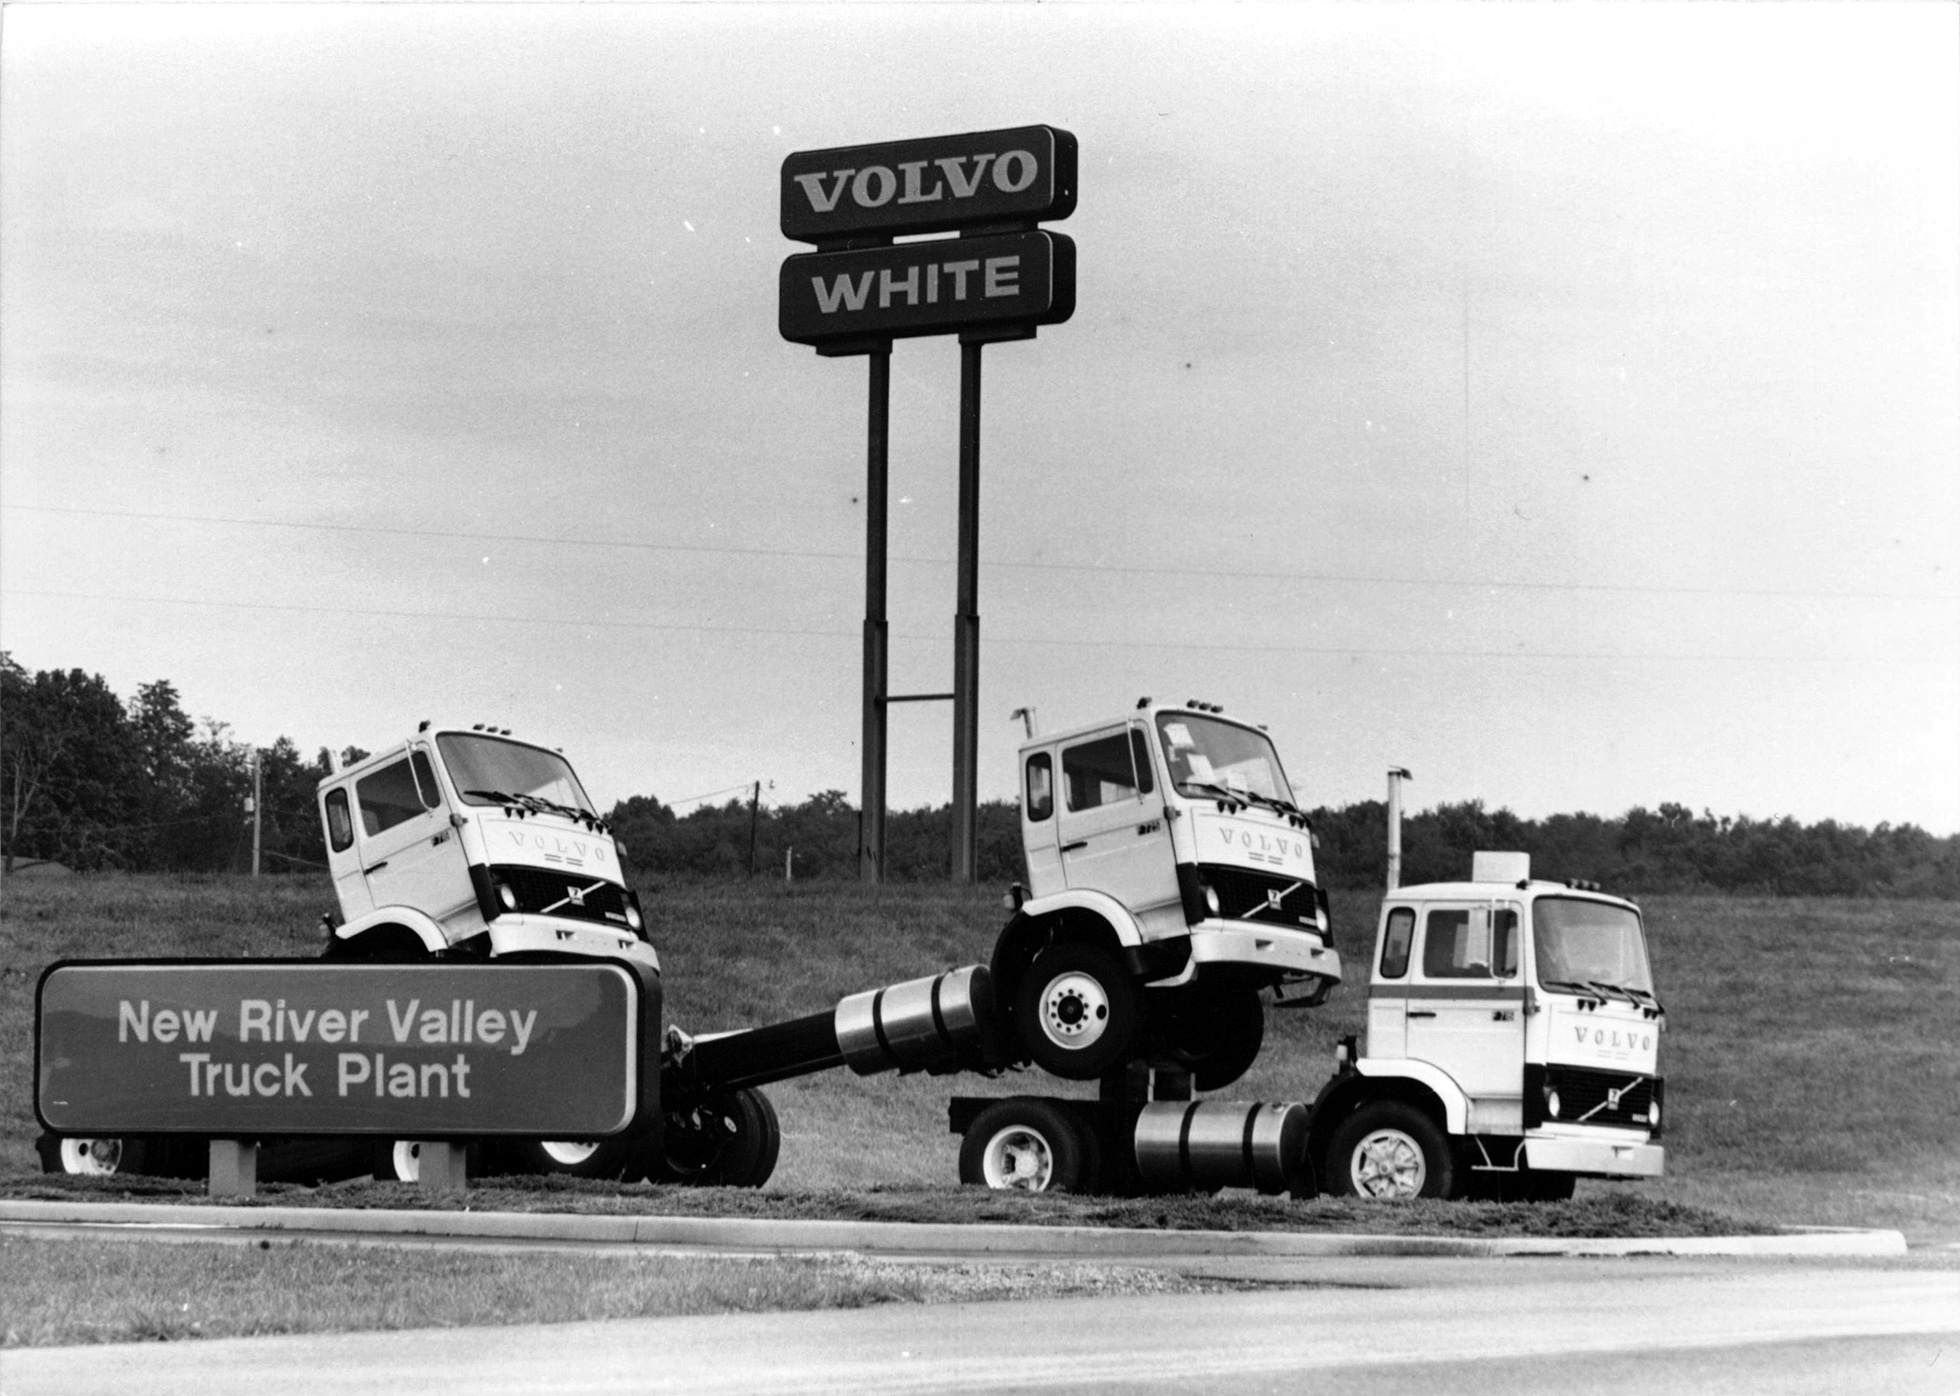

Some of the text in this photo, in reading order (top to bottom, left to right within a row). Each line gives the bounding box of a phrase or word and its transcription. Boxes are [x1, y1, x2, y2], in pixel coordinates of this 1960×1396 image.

[794, 150, 1038, 212] VOLVO
[811, 255, 1020, 314] WHITE
[509, 831, 605, 862] VOLVO
[1219, 827, 1303, 858] VOLVO
[119, 1000, 538, 1055] New River Valley
[1574, 1026, 1651, 1051] VOLVO
[180, 1053, 471, 1098] Truck Plant
